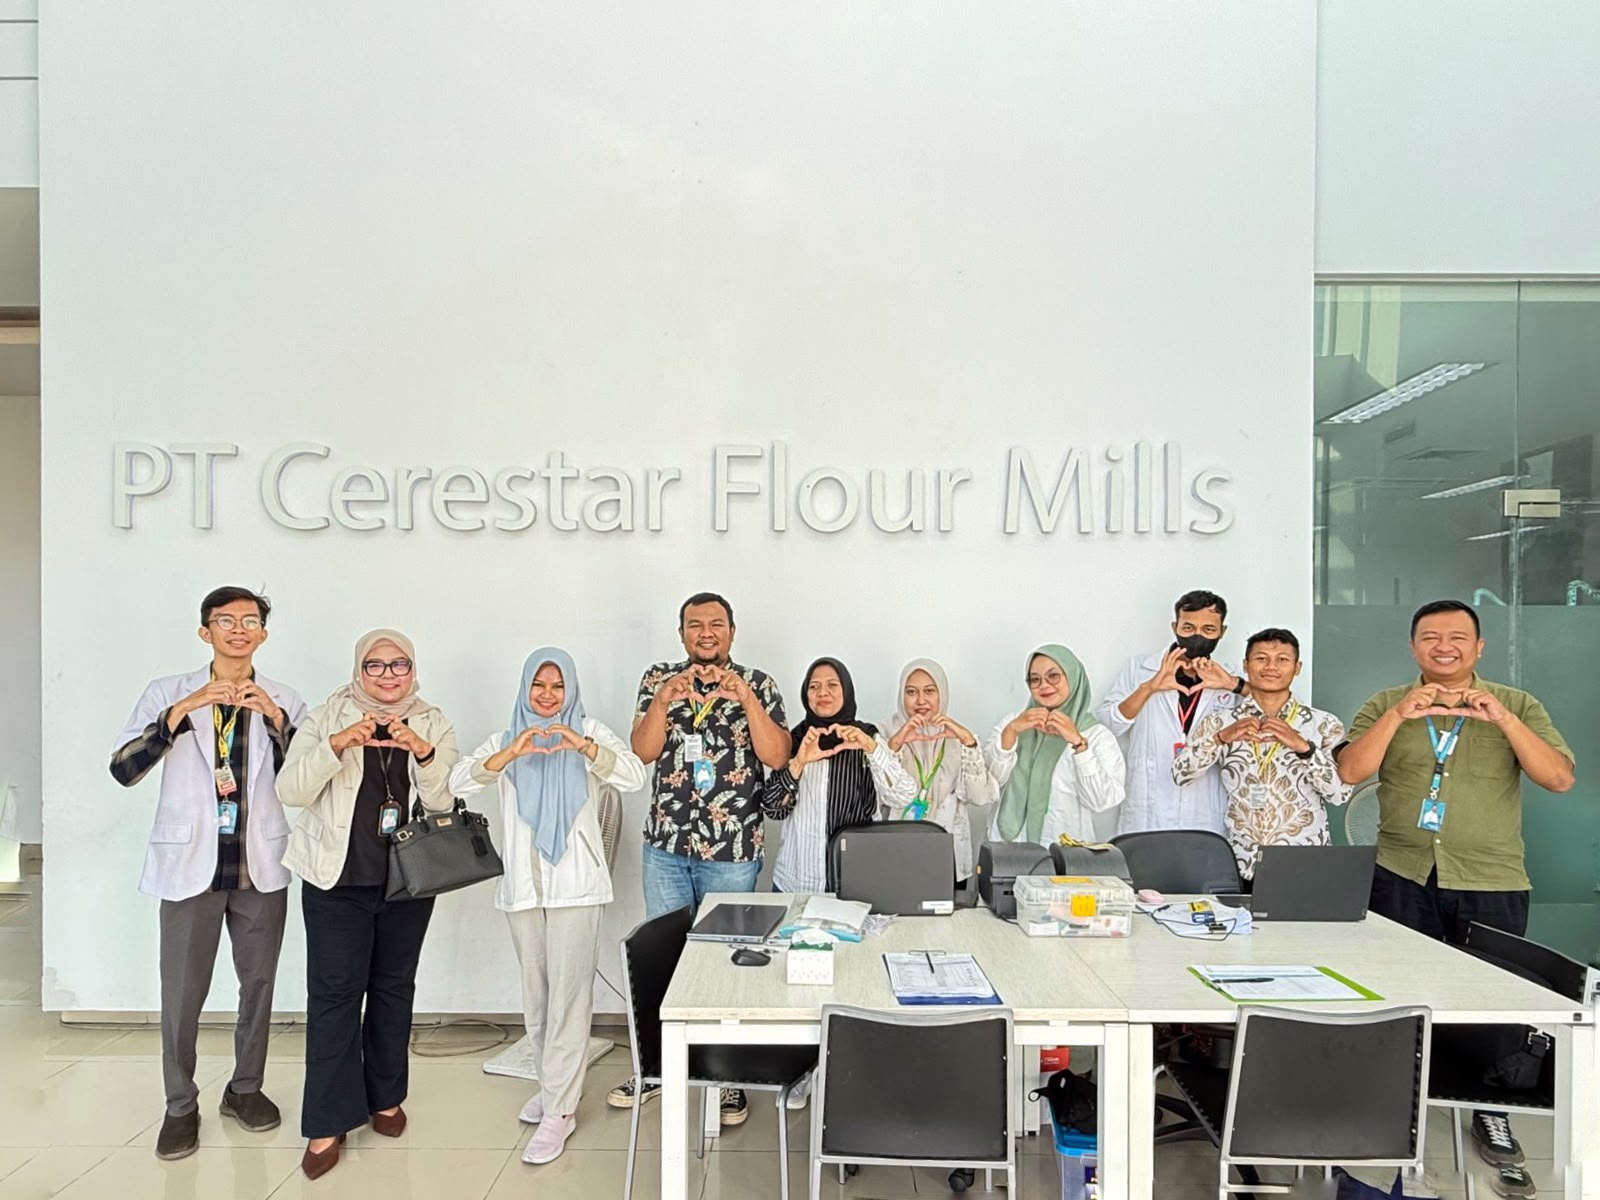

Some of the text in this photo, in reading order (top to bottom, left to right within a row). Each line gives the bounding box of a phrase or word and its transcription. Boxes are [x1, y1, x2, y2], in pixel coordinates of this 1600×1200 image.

[112, 440, 1235, 534] PT Cerestar Flour Mills
